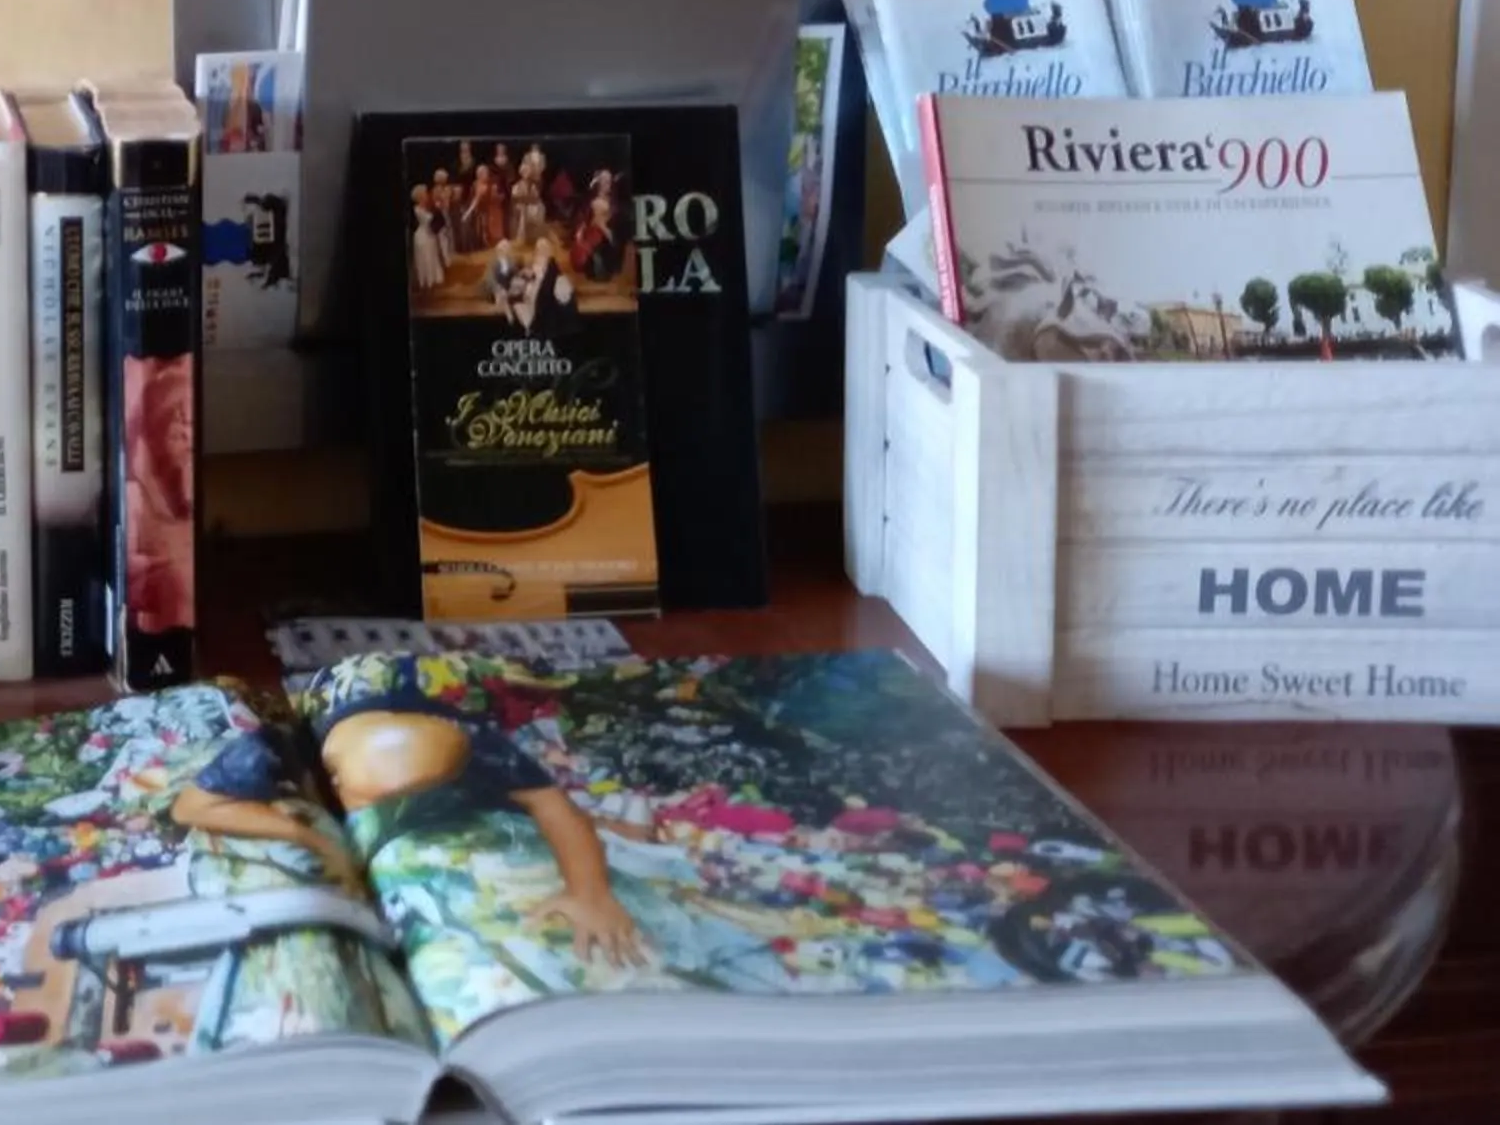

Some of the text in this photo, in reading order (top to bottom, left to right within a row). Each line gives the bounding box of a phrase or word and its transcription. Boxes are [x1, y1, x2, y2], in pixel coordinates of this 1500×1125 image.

[632, 191, 718, 242] RO
[477, 359, 573, 376] CONCERTO
[491, 339, 555, 357] OPERA
[1153, 476, 1485, 531] There's no place like
[1198, 567, 1427, 618] HOME
[1151, 660, 1468, 698] Home Sweet Home
